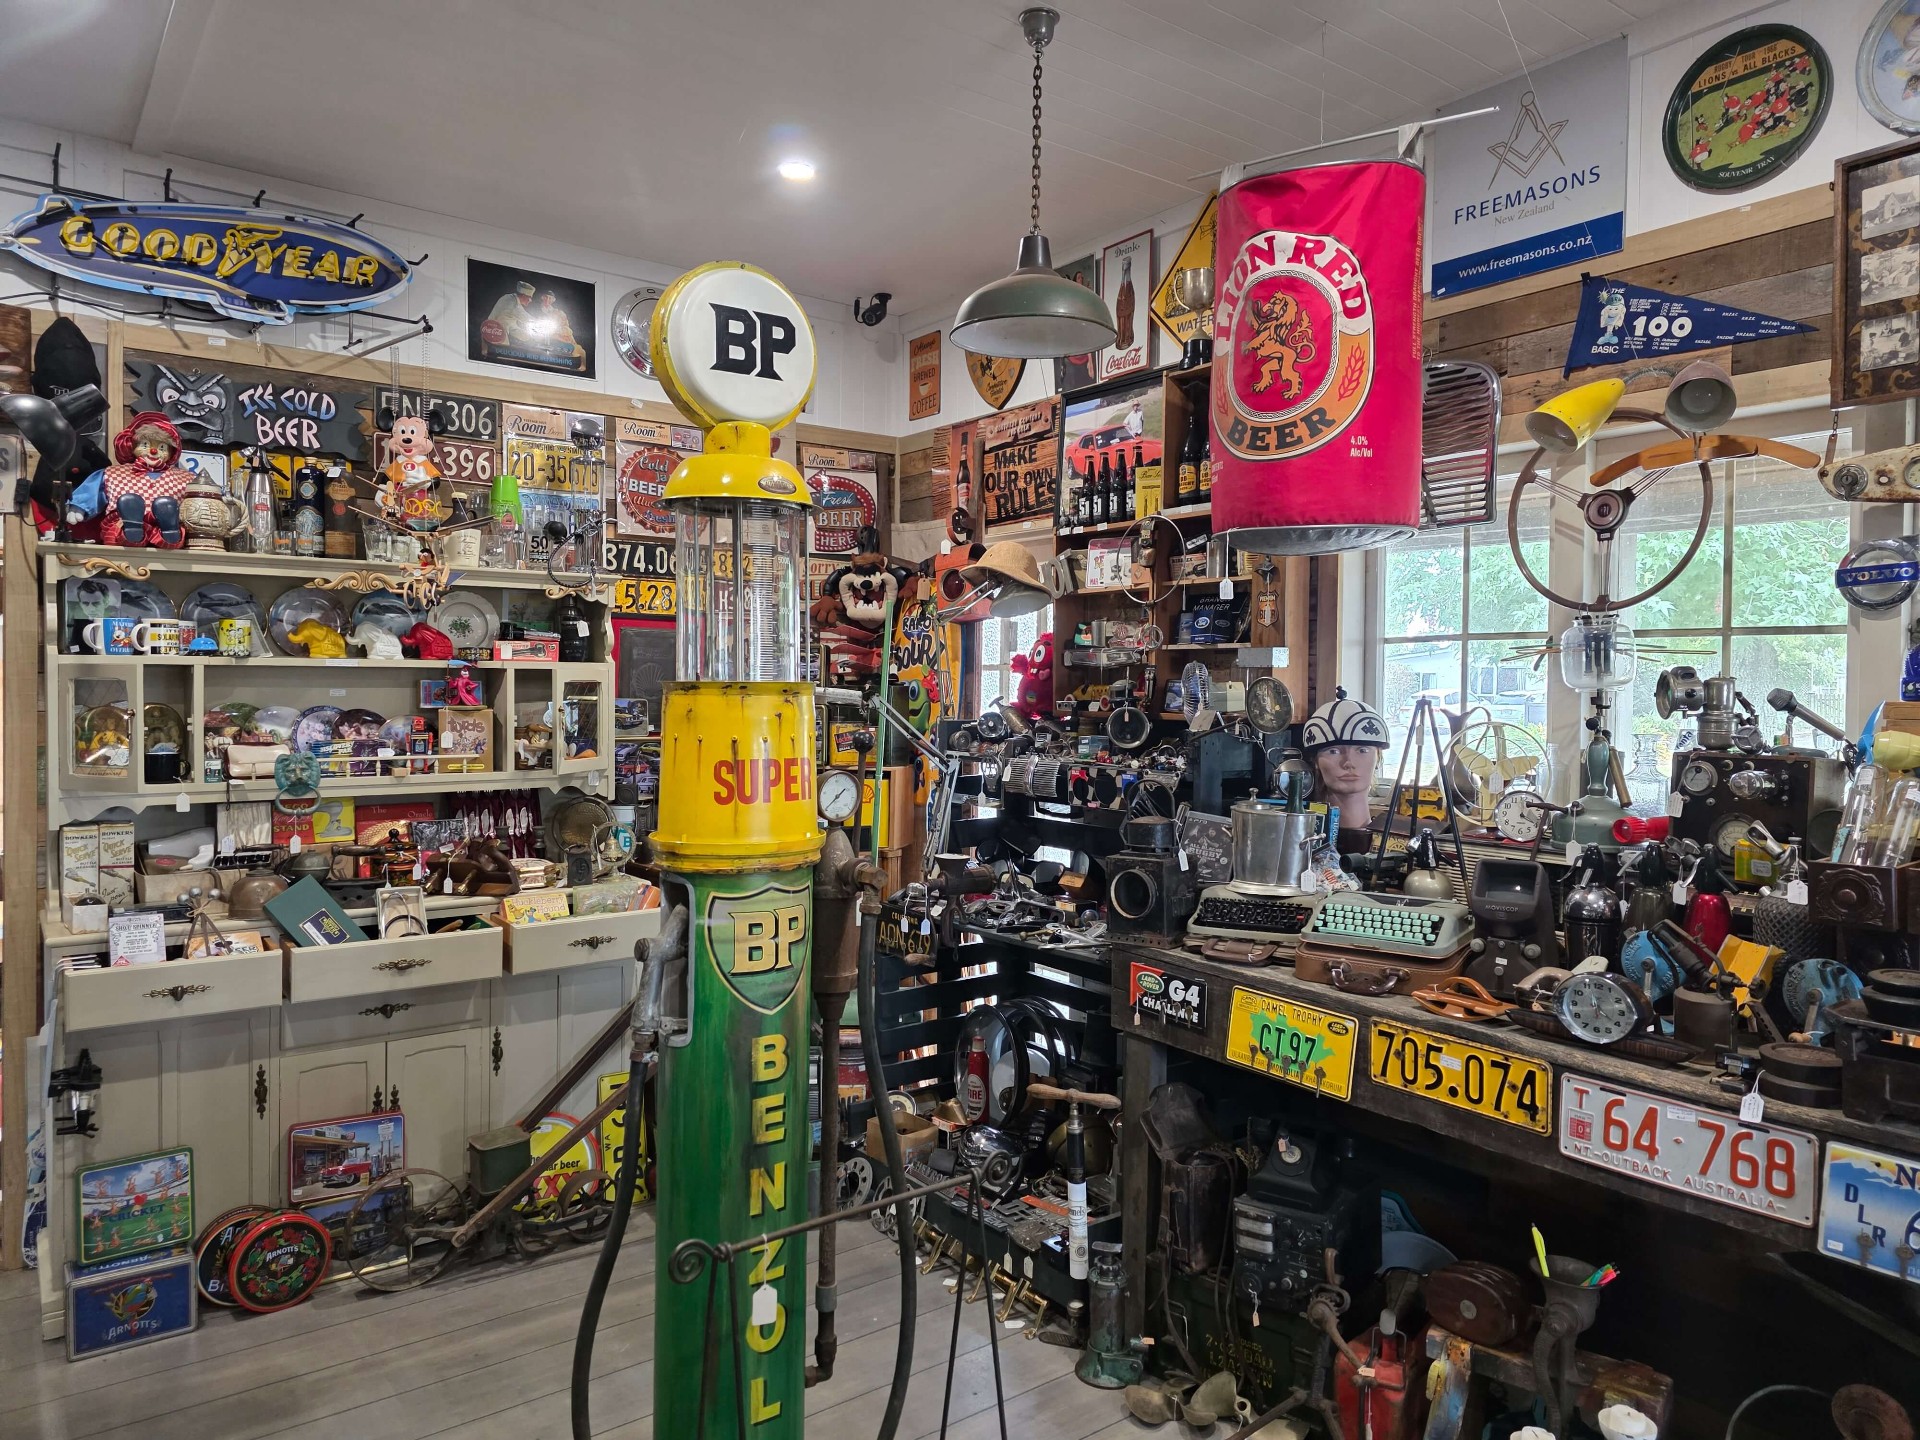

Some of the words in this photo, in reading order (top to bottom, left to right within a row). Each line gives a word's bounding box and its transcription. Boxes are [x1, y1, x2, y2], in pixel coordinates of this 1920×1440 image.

[1698, 71, 1726, 88] LIONS
[1743, 61, 1758, 72] ALL
[1761, 46, 1797, 65] BLACKS
[1718, 167, 1753, 178] SOUVENIR
[1757, 156, 1775, 169] TRAY
[1454, 165, 1601, 225] FREEMASONS
[1494, 212, 1518, 227] New
[1517, 201, 1555, 221] Zealand
[1114, 241, 1140, 258] Drink
[1458, 234, 1592, 278] www.freemasons.co.nz
[1216, 235, 1277, 342] LION
[1286, 235, 1368, 320] RED
[1633, 316, 1693, 338] 100
[709, 302, 797, 382] BP
[1591, 345, 1619, 354] BASIC
[911, 350, 939, 372] FRESH
[1105, 345, 1143, 373] Coca-Cola
[913, 367, 937, 383] BREWED
[238, 383, 279, 419] ICE
[280, 388, 337, 421] COLD
[912, 394, 938, 415] COFFEE
[254, 411, 322, 450] BEER
[506, 414, 547, 435] Room
[624, 421, 656, 438] Room
[1227, 407, 1337, 452] BEER
[1350, 436, 1368, 446] 4.0%
[809, 453, 836, 467] Room
[994, 444, 1038, 470] MAKE
[1350, 447, 1373, 458] Alc/Vol
[983, 467, 1018, 494] OUR
[1024, 467, 1053, 486] OWN
[823, 491, 855, 506] Fresh
[995, 476, 1056, 518] RULES
[818, 510, 863, 527] BEER
[531, 535, 549, 549] 50
[820, 534, 857, 547] HERE
[802, 563, 840, 575] orry
[1841, 566, 1915, 584] VOLVO
[1192, 603, 1231, 611] MANAGER
[1260, 610, 1276, 620] BR
[895, 634, 933, 671] SOUR
[713, 756, 812, 806] SUPER
[372, 806, 387, 814] The
[407, 810, 433, 819] Oracle
[274, 824, 310, 833] STAND
[511, 894, 565, 906] Huckleberry
[537, 902, 566, 913] Hound
[1485, 904, 1519, 913] MOVISCOP
[729, 904, 806, 977] BP
[1142, 973, 1157, 984] LAND
[1143, 980, 1160, 990] ROVER
[1168, 980, 1200, 1007] G4
[1261, 1000, 1287, 1018] CAMEL
[1292, 1008, 1324, 1027] TROPHY
[1330, 1026, 1347, 1035] ROVER
[1331, 1022, 1346, 1030] LAND
[1271, 1063, 1300, 1079] MONOLIA
[1376, 1028, 1540, 1123] 705.074
[967, 1090, 983, 1100] FIRE
[1574, 1085, 1591, 1110] T
[560, 1159, 581, 1170] beer
[108, 1204, 166, 1223] CRICKET
[745, 1034, 788, 1425] BENZOL
[266, 1245, 299, 1262] ARNOTT'S
[107, 1319, 158, 1340] ARNOTT'S
